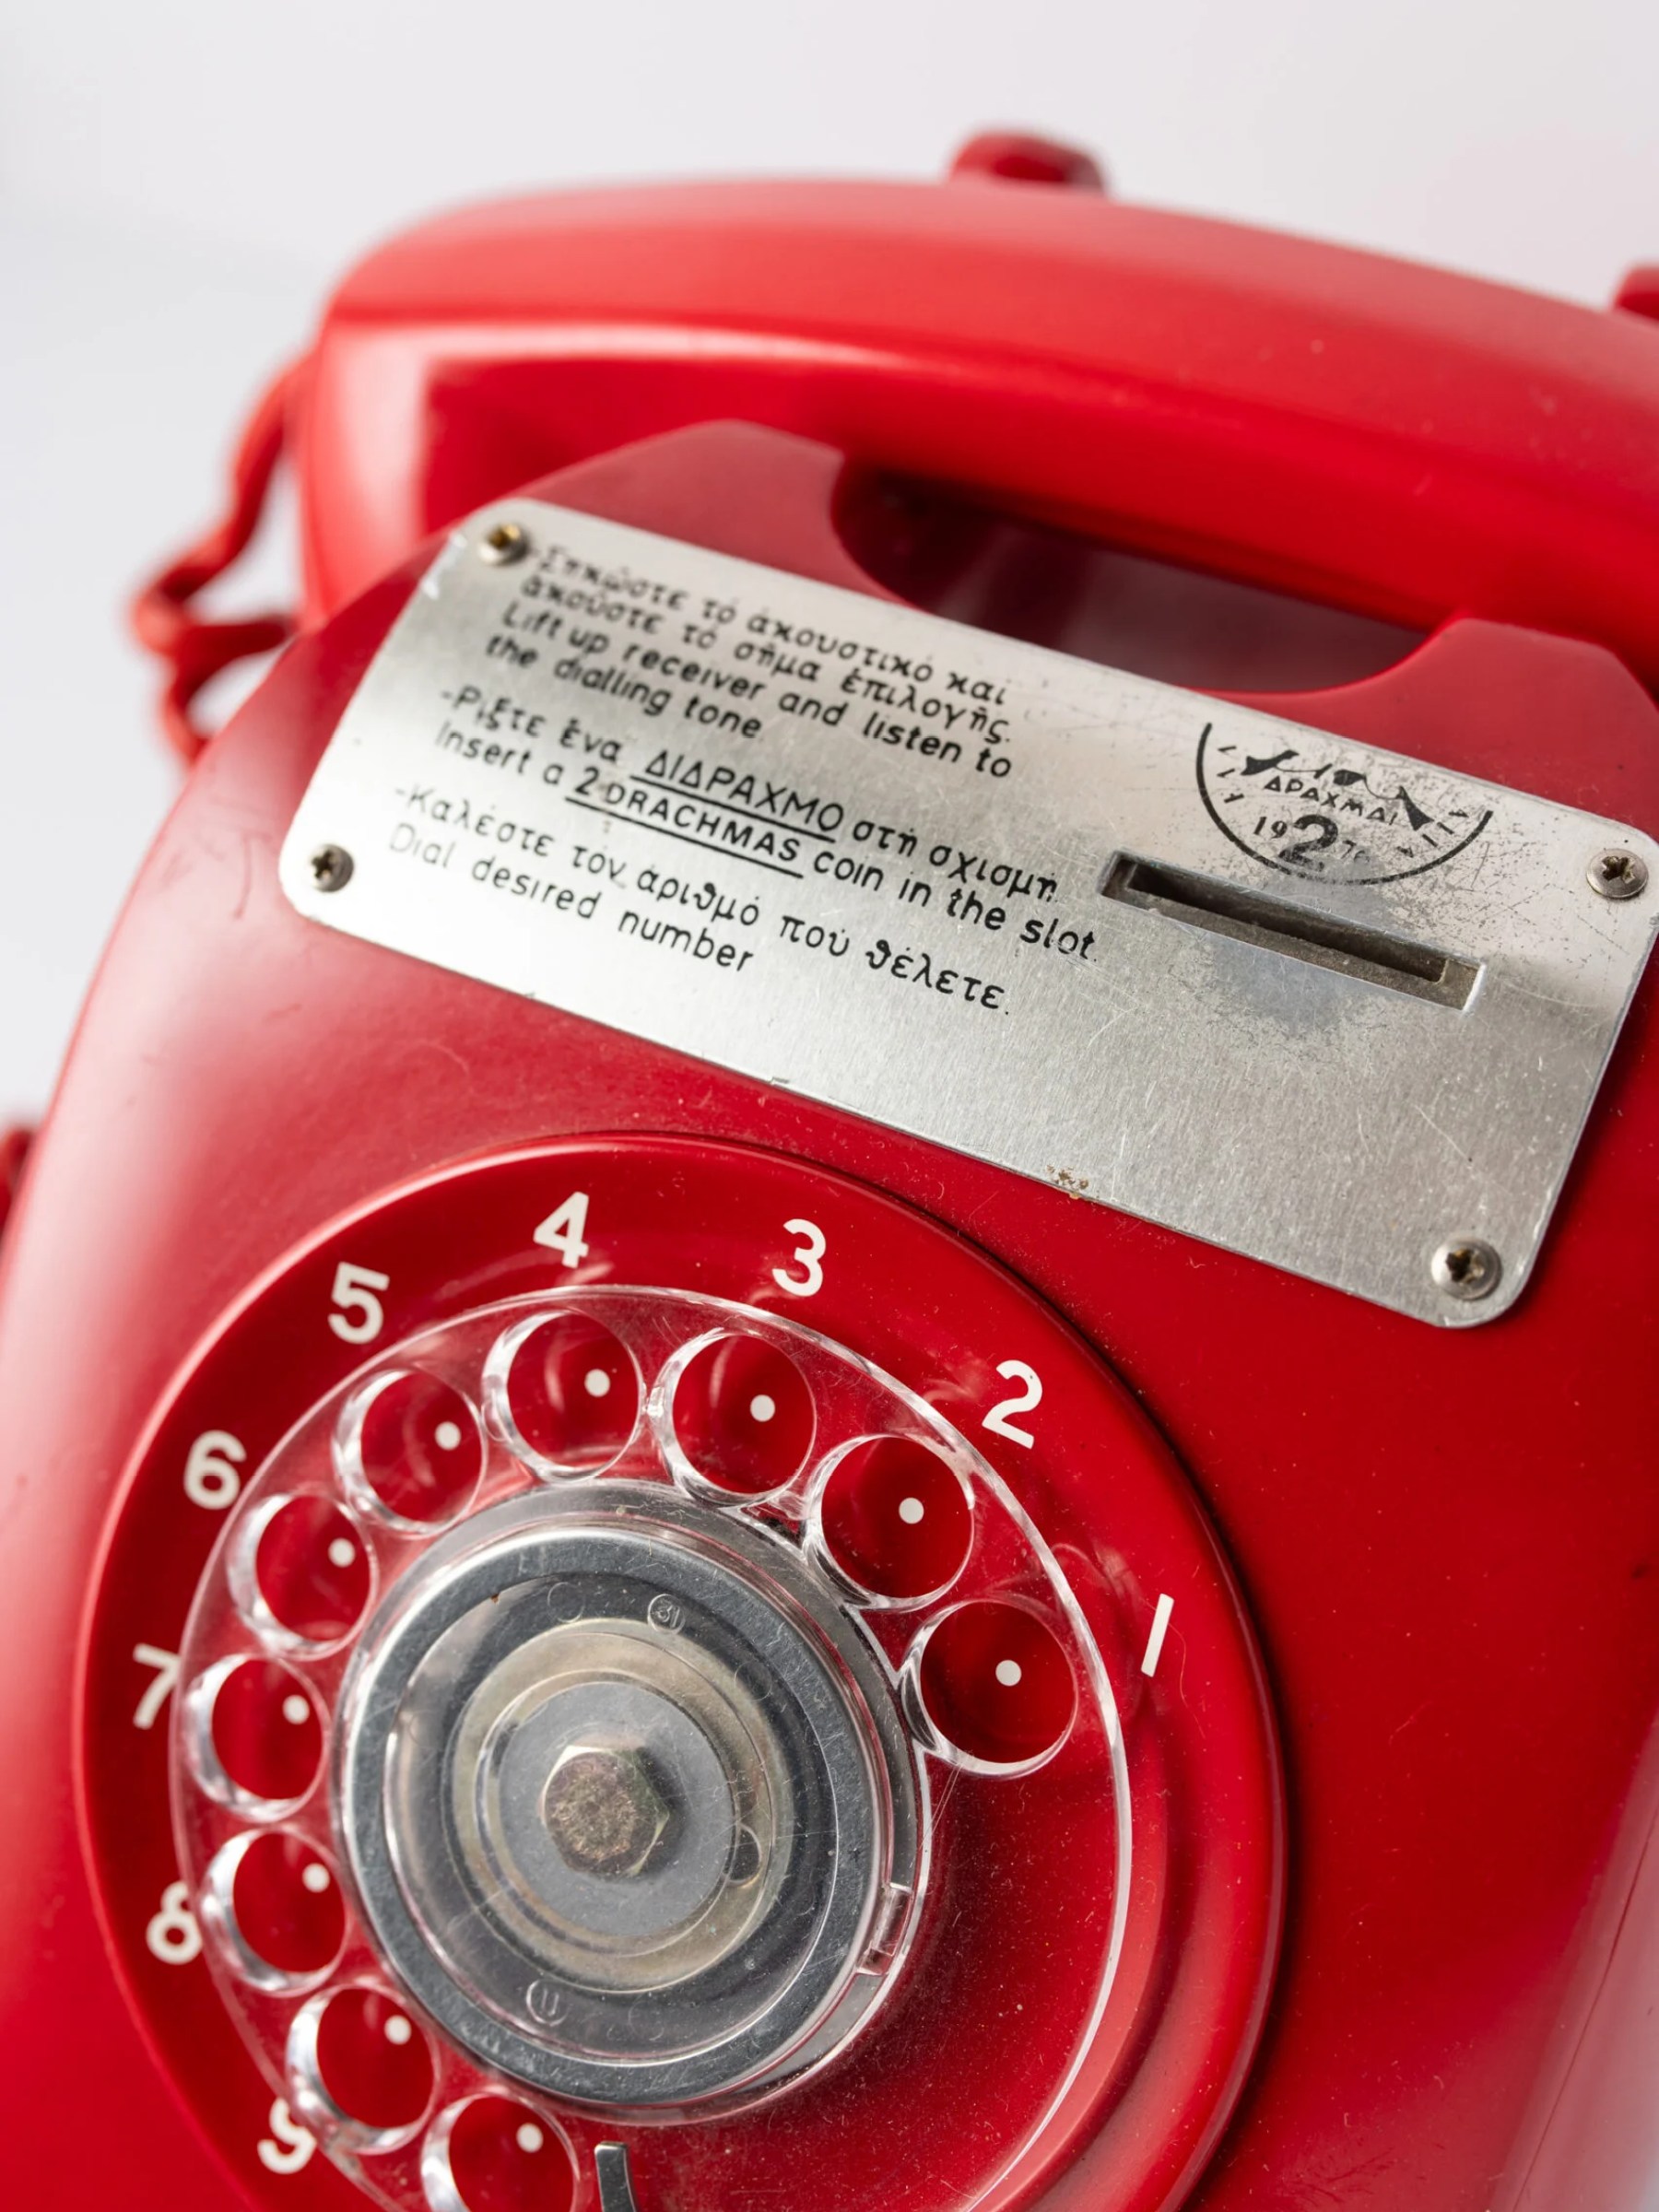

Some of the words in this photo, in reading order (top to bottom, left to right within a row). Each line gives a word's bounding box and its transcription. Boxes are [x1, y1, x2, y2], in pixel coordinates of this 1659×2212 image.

[486, 634, 538, 668] the
[554, 654, 672, 717] dialling
[684, 695, 761, 738] tone
[502, 600, 563, 640] Lift
[568, 627, 610, 656] up
[623, 643, 766, 700] receiver
[779, 691, 849, 726] and
[863, 712, 961, 763] listen
[975, 747, 1011, 779] to
[435, 720, 531, 775] Insert
[543, 763, 564, 785] a
[574, 765, 599, 796] 2
[605, 782, 801, 862] DRACHMAS
[814, 851, 884, 891] coin
[899, 871, 932, 908] in
[947, 888, 1006, 931] the
[645, 749, 844, 832] ΔΙΔΡΑΧΜΟ
[1278, 814, 1339, 872] 2
[389, 822, 456, 869] Dial
[472, 855, 603, 920] desired
[618, 910, 754, 972] number
[533, 1192, 590, 1268] 4
[772, 1218, 827, 1297] 3
[327, 1262, 389, 1344] 5
[982, 1359, 1042, 1449] 2
[183, 1431, 246, 1511] 6
[1141, 1593, 1174, 1677] 1
[133, 1642, 182, 1730] 7
[146, 1880, 203, 1965] 8
